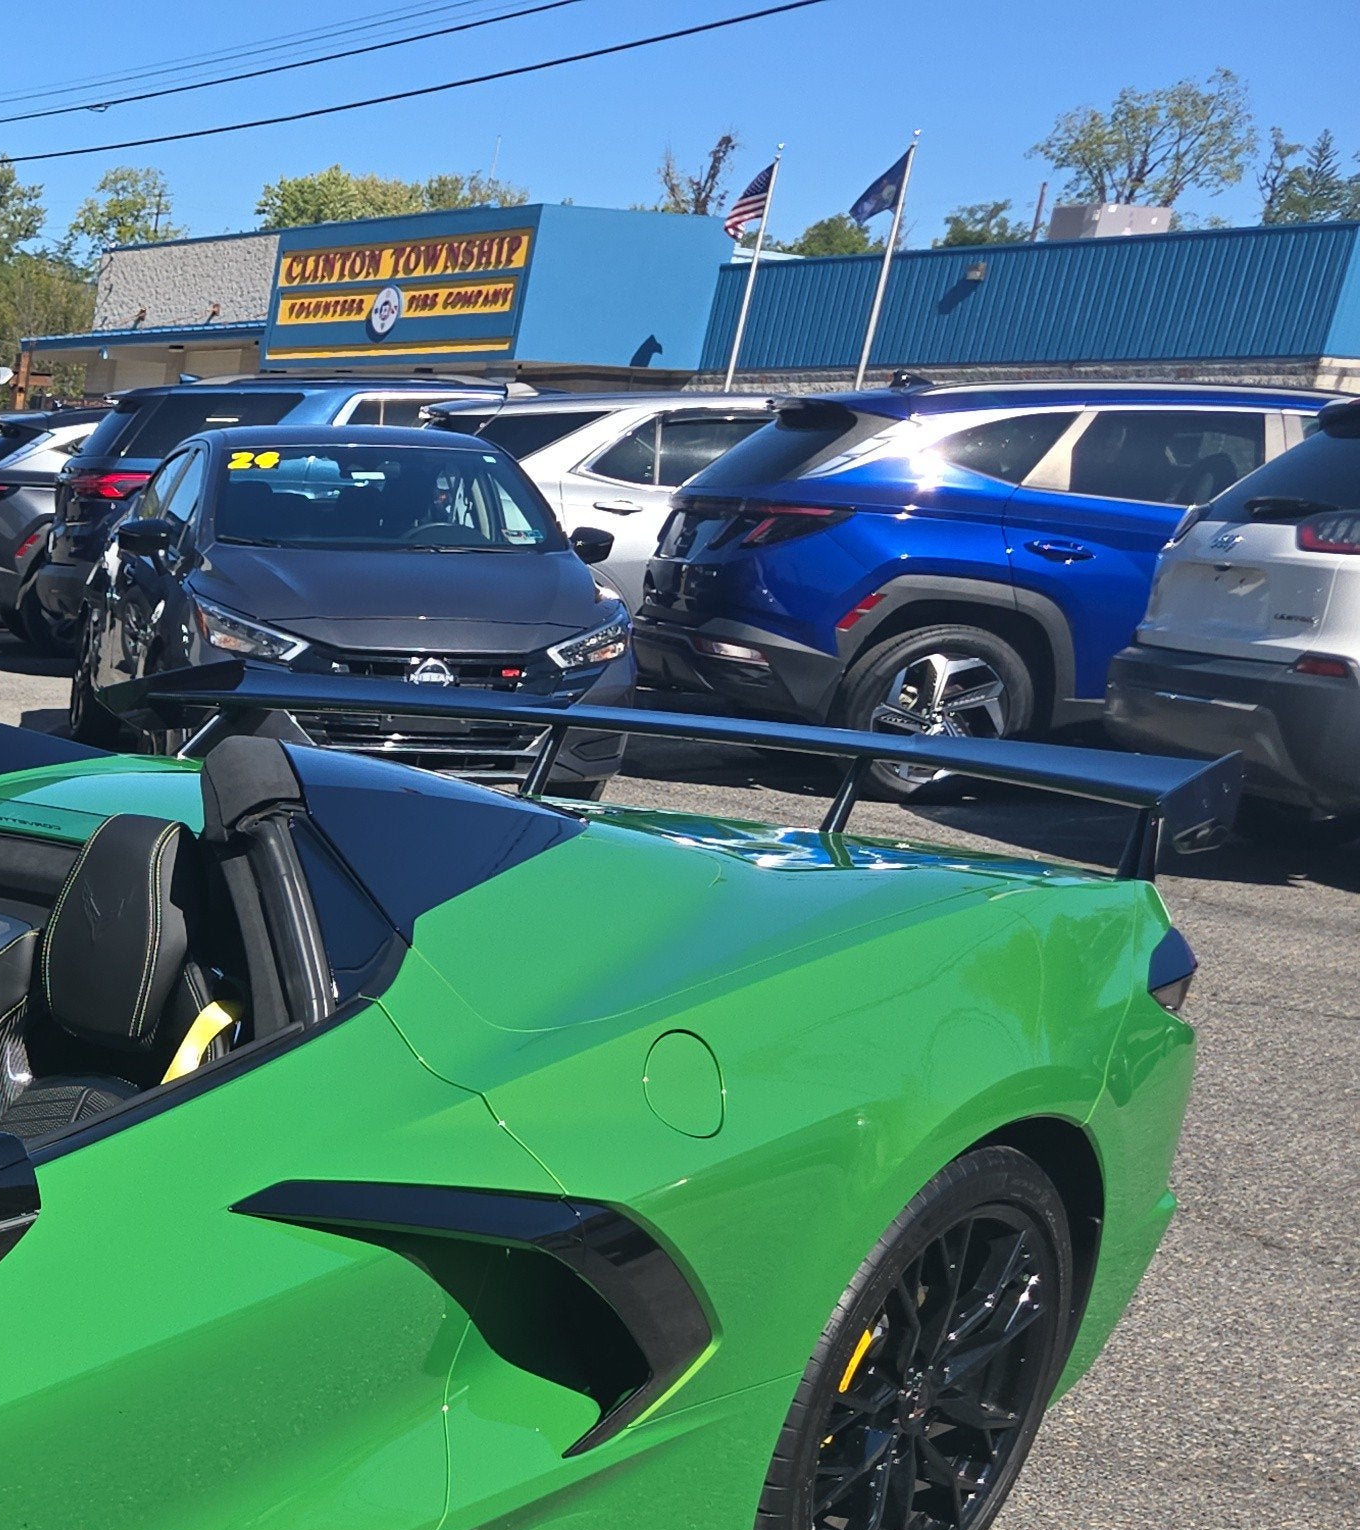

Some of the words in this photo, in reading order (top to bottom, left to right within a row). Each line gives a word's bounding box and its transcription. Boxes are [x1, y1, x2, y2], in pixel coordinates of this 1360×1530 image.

[285, 248, 383, 285] CLINTON
[390, 235, 523, 278] TOWNSHIP
[288, 298, 365, 319] VOLUNTEER
[407, 292, 440, 313] FIRE
[442, 287, 513, 310] COMPANY
[226, 451, 281, 471] 24
